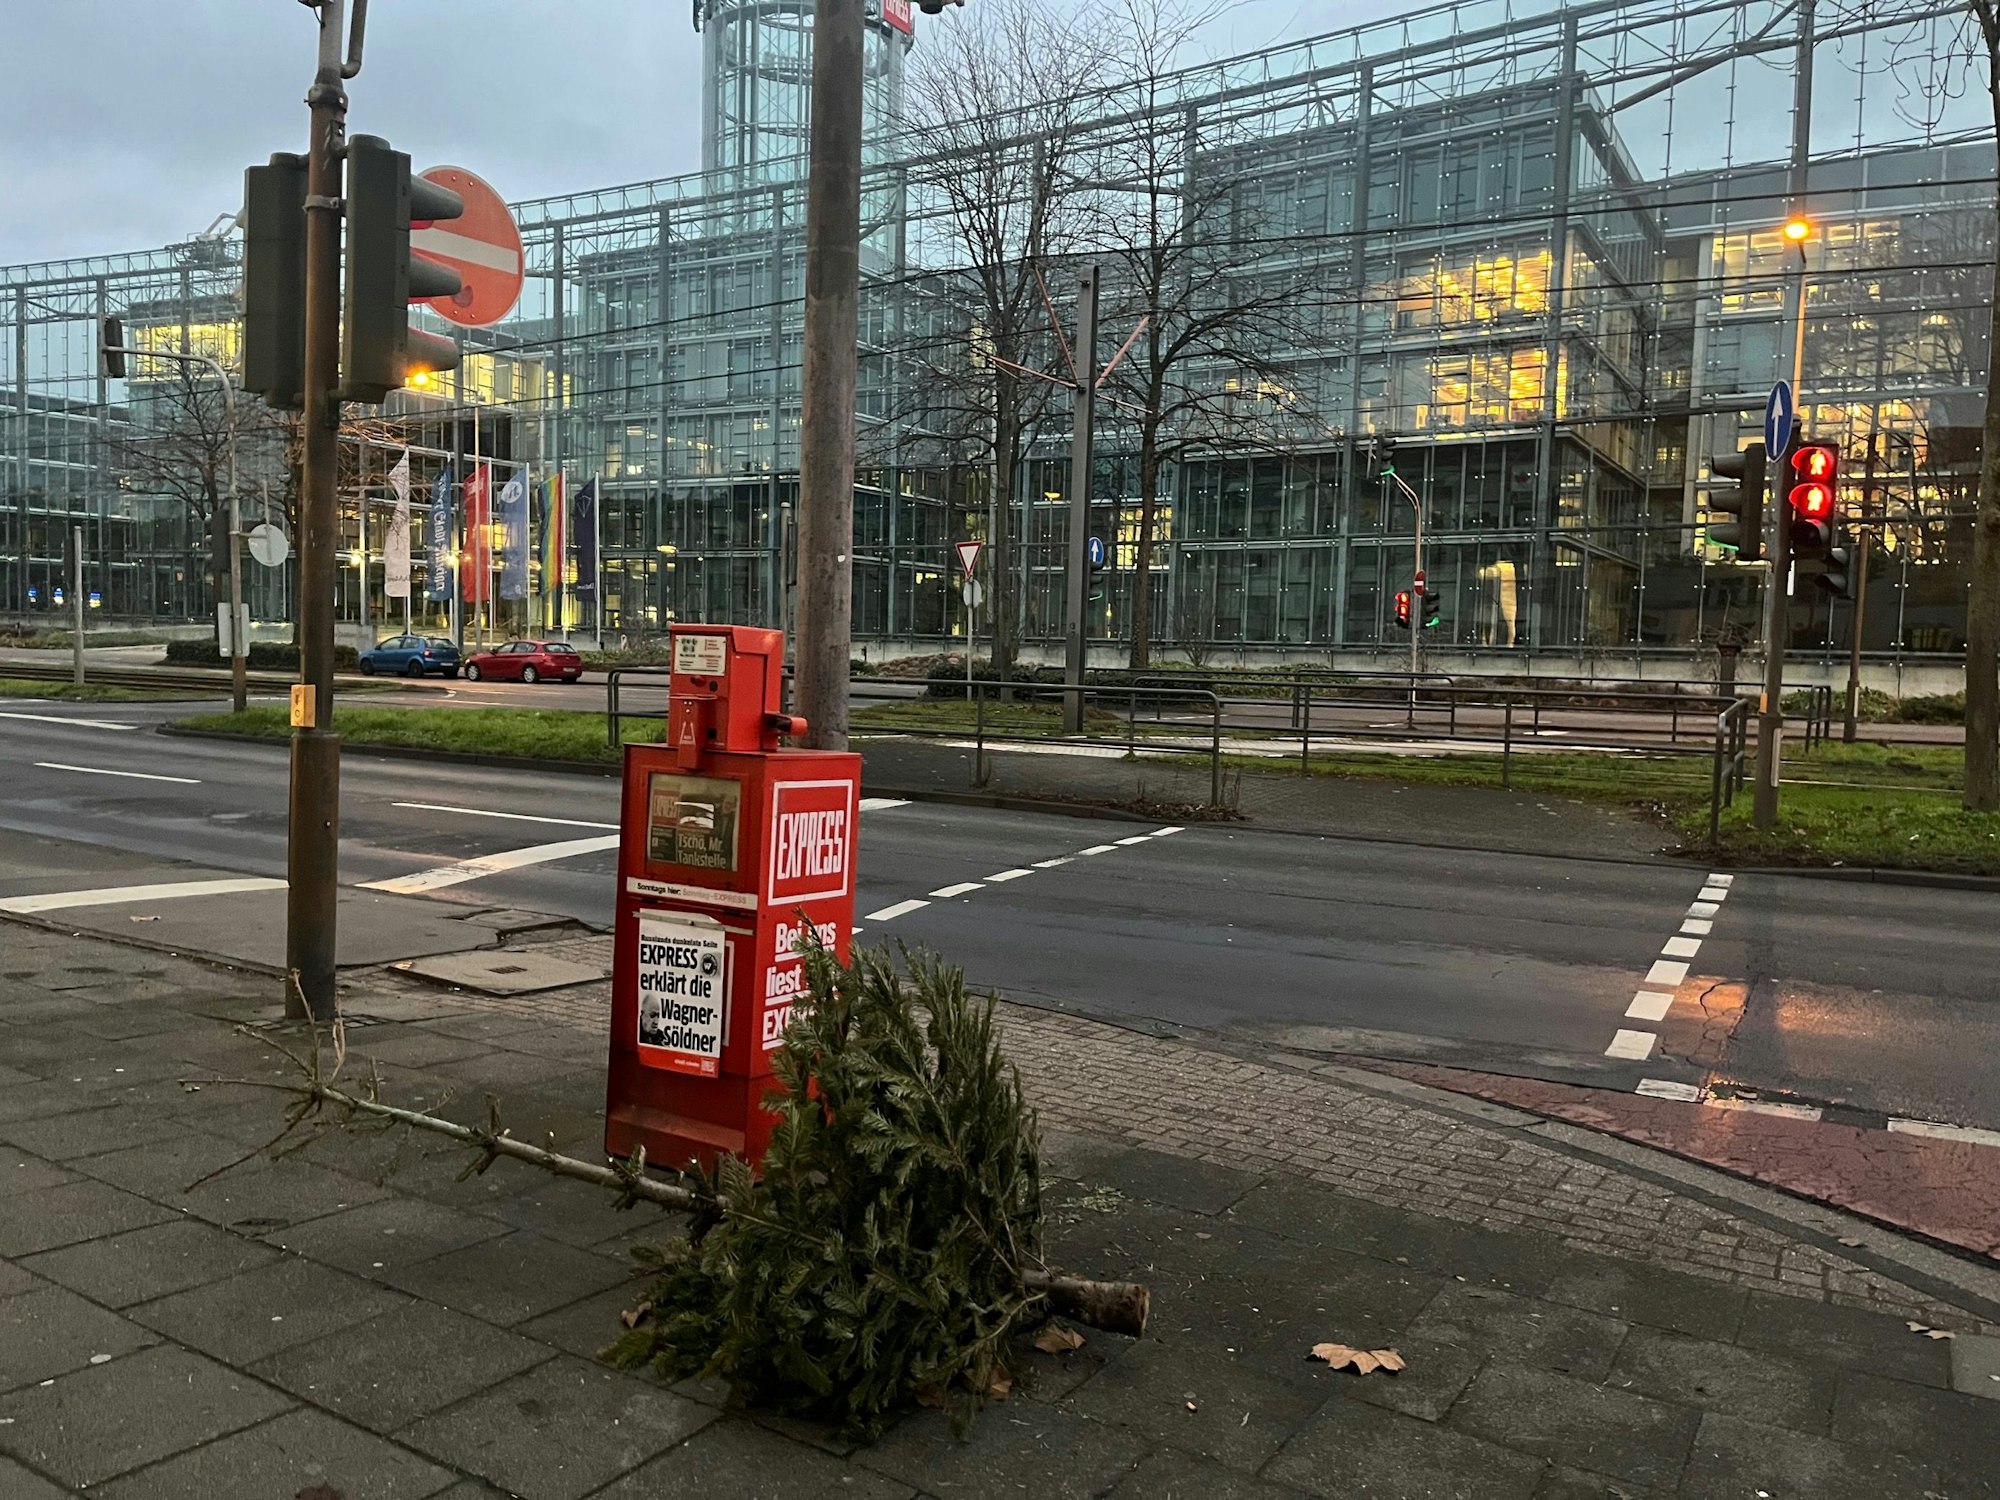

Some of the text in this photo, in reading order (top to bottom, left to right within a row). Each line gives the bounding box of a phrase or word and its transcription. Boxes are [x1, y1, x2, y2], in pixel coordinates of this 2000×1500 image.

[778, 810, 844, 880] EXPRESS
[678, 850, 727, 868] Tankstelle
[637, 882, 666, 895] Sonntags
[640, 944, 698, 970] EXPRESS
[703, 940, 718, 948] Seite
[640, 970, 712, 998] erklärt die
[767, 964, 801, 997] liest
[661, 998, 718, 1025] Wagner-
[664, 1026, 716, 1053] Söldner
